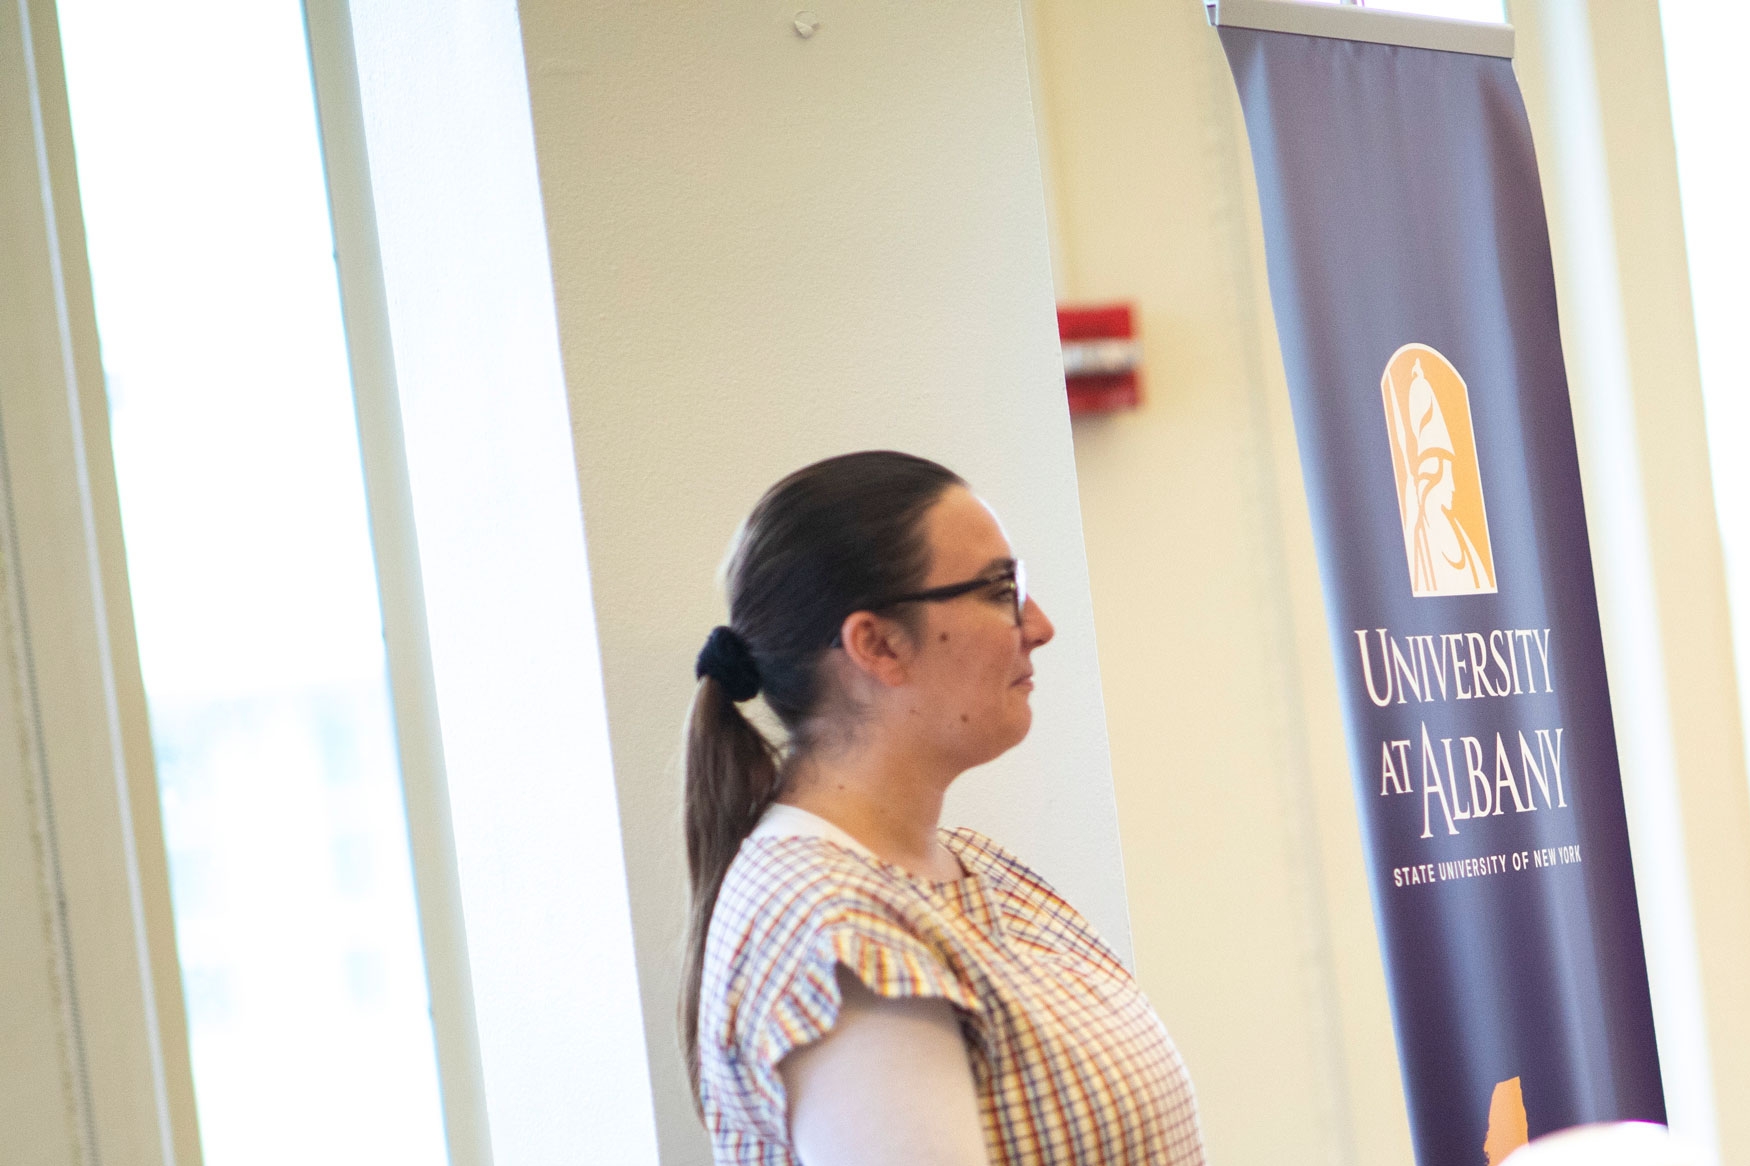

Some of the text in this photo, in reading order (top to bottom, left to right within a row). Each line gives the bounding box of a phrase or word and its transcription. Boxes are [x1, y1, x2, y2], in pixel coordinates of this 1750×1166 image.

[1354, 628, 1554, 707] UNIVERSITY
[1380, 720, 1567, 838] AT ALBANY
[1393, 844, 1582, 888] STATE UNIVERSITY OF NEW YORK
